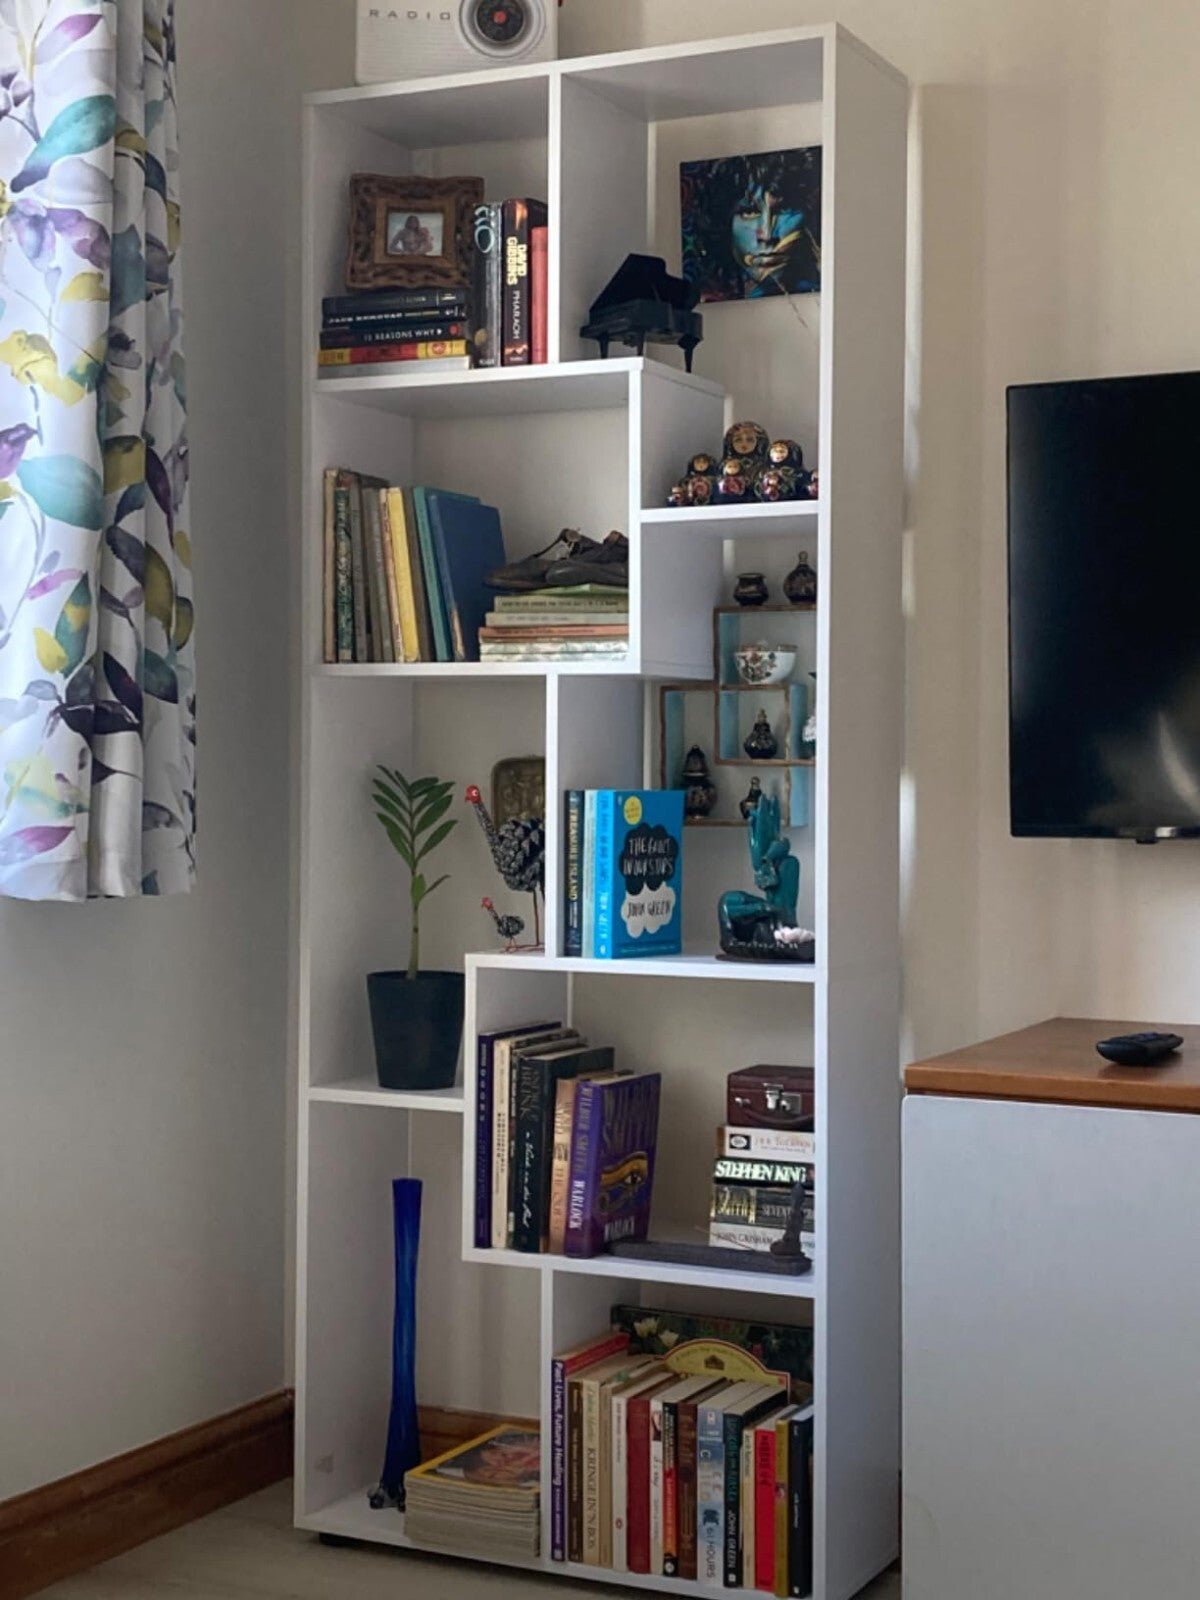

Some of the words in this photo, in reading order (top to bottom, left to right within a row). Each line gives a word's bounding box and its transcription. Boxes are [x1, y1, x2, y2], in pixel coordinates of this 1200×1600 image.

[369, 9, 451, 21] RADIO
[507, 236, 518, 285] GIBBINS
[517, 244, 528, 277] DAVID
[512, 290, 521, 340] PHARAOH
[375, 330, 413, 341] REASONS
[415, 328, 435, 338] WHY
[569, 808, 579, 860] TREASURE
[629, 837, 647, 856] THE
[569, 862, 579, 901] ISLAND
[714, 1160, 774, 1182] STEPHEN
[774, 1167, 806, 1184] KING
[569, 1180, 586, 1230] WARLOCK
[554, 1361, 564, 1384] Past
[554, 1413, 564, 1446] Future
[553, 1449, 564, 1486] Healing
[587, 1446, 597, 1495] KRINGE
[727, 1509, 737, 1535] JOHN
[706, 1539, 717, 1578] HOURS
[727, 1537, 737, 1569] GREEN
